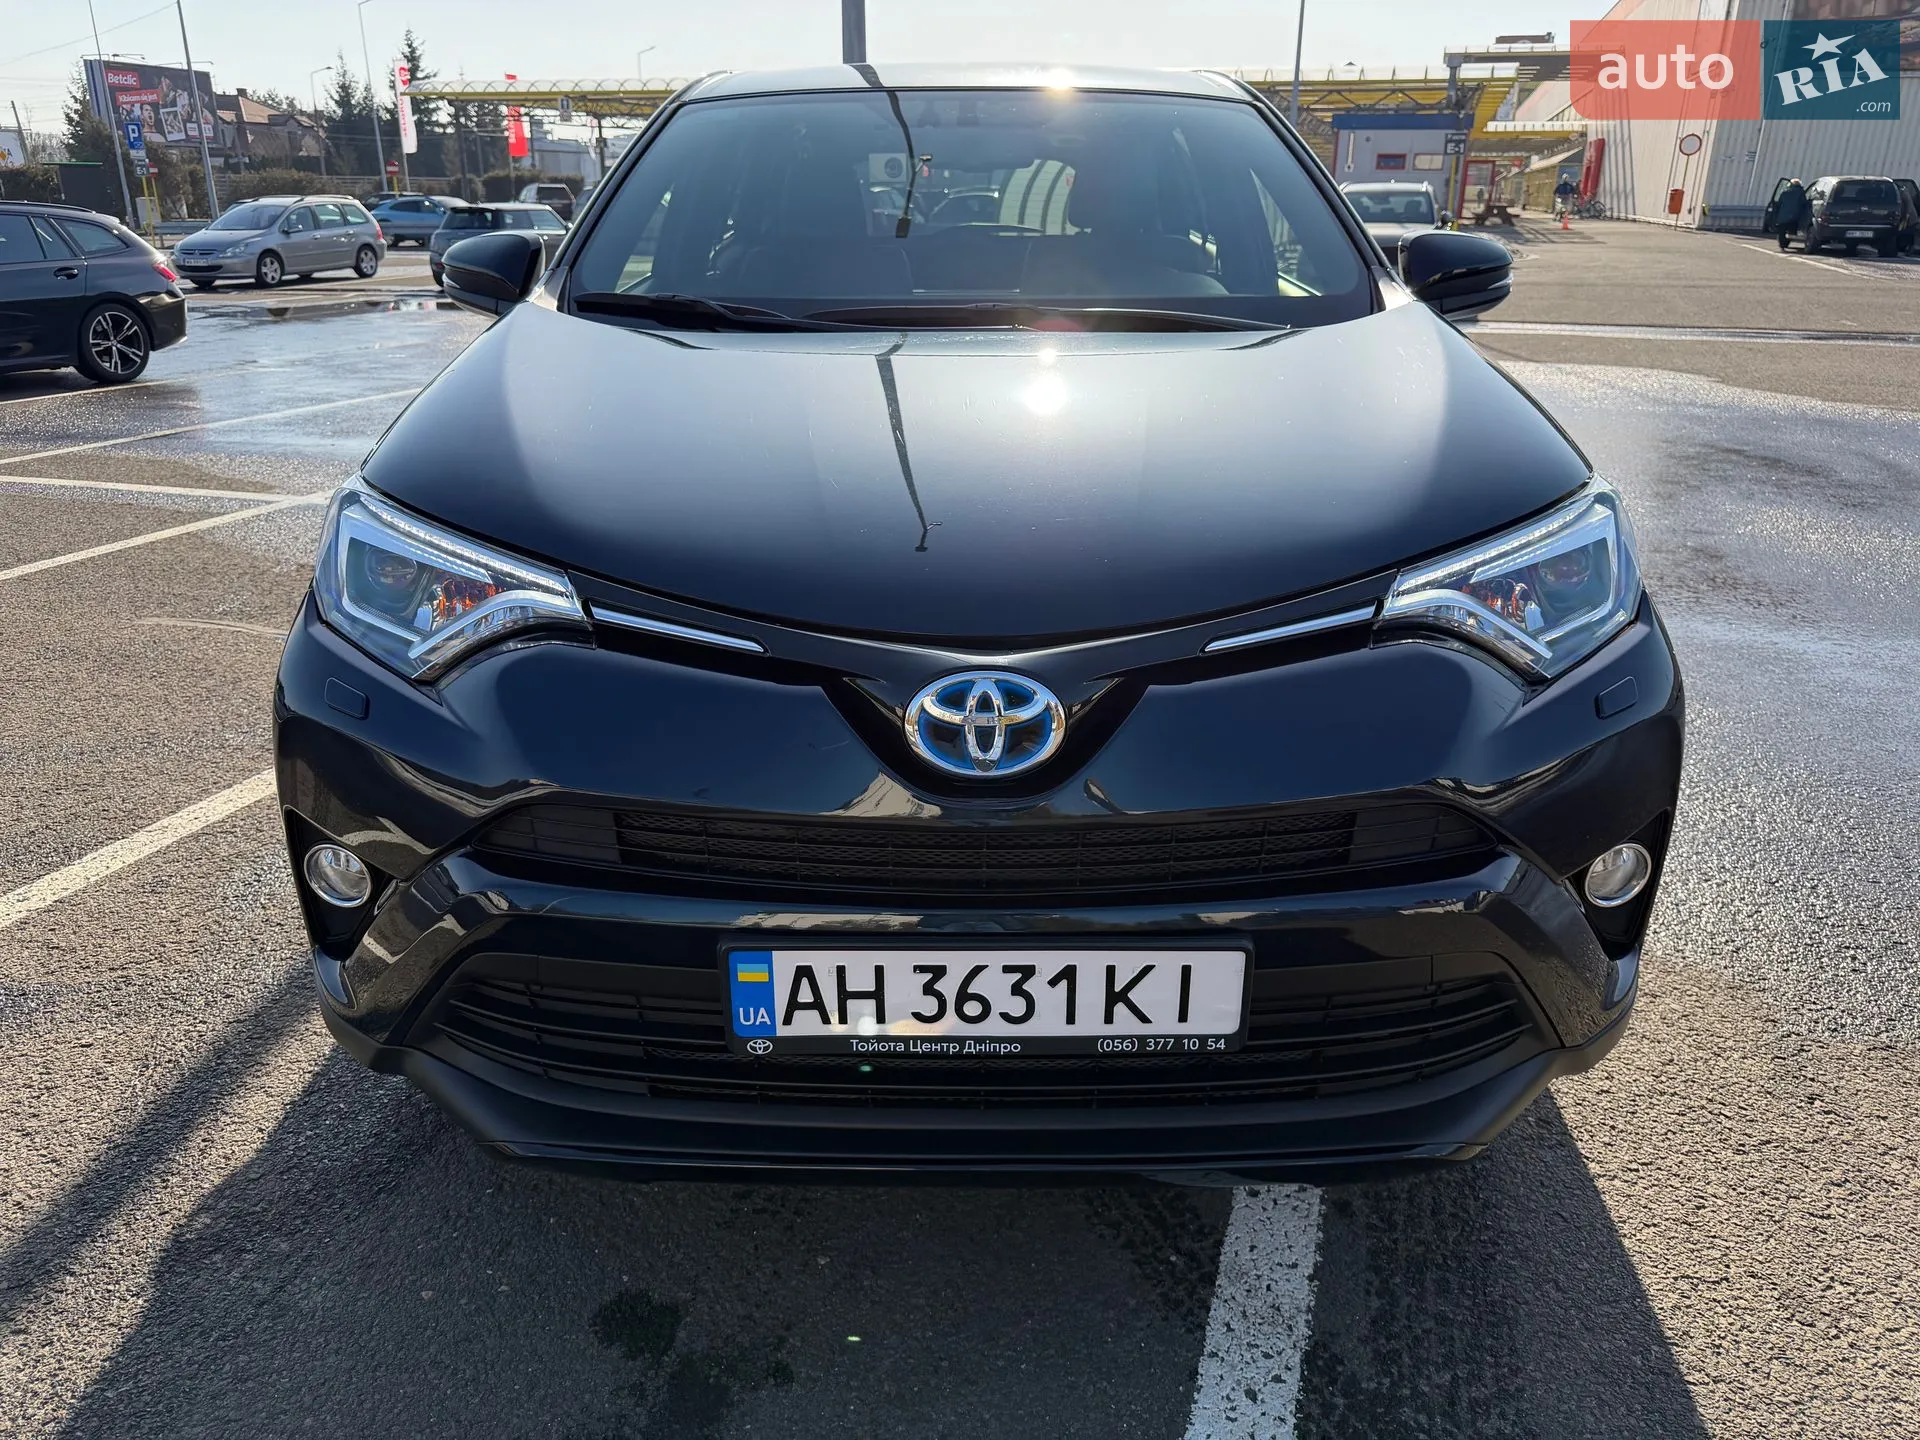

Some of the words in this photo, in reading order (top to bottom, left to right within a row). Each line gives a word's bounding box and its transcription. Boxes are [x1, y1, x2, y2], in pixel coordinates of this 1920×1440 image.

[108, 73, 137, 85] Betclic
[128, 124, 139, 142] P
[1446, 142, 1465, 154] E-1
[782, 964, 886, 1026] AH
[910, 964, 1078, 1026] 3631
[1103, 963, 1193, 1025] KI
[739, 1007, 771, 1026] UA
[850, 1039, 905, 1052] Тойота
[909, 1040, 960, 1055] Центр
[963, 1040, 1021, 1055] Дніпро
[1097, 1037, 1139, 1053] (056)
[1146, 1038, 1175, 1051] 377
[1182, 1038, 1199, 1051] 10
[1206, 1038, 1226, 1051] 54
